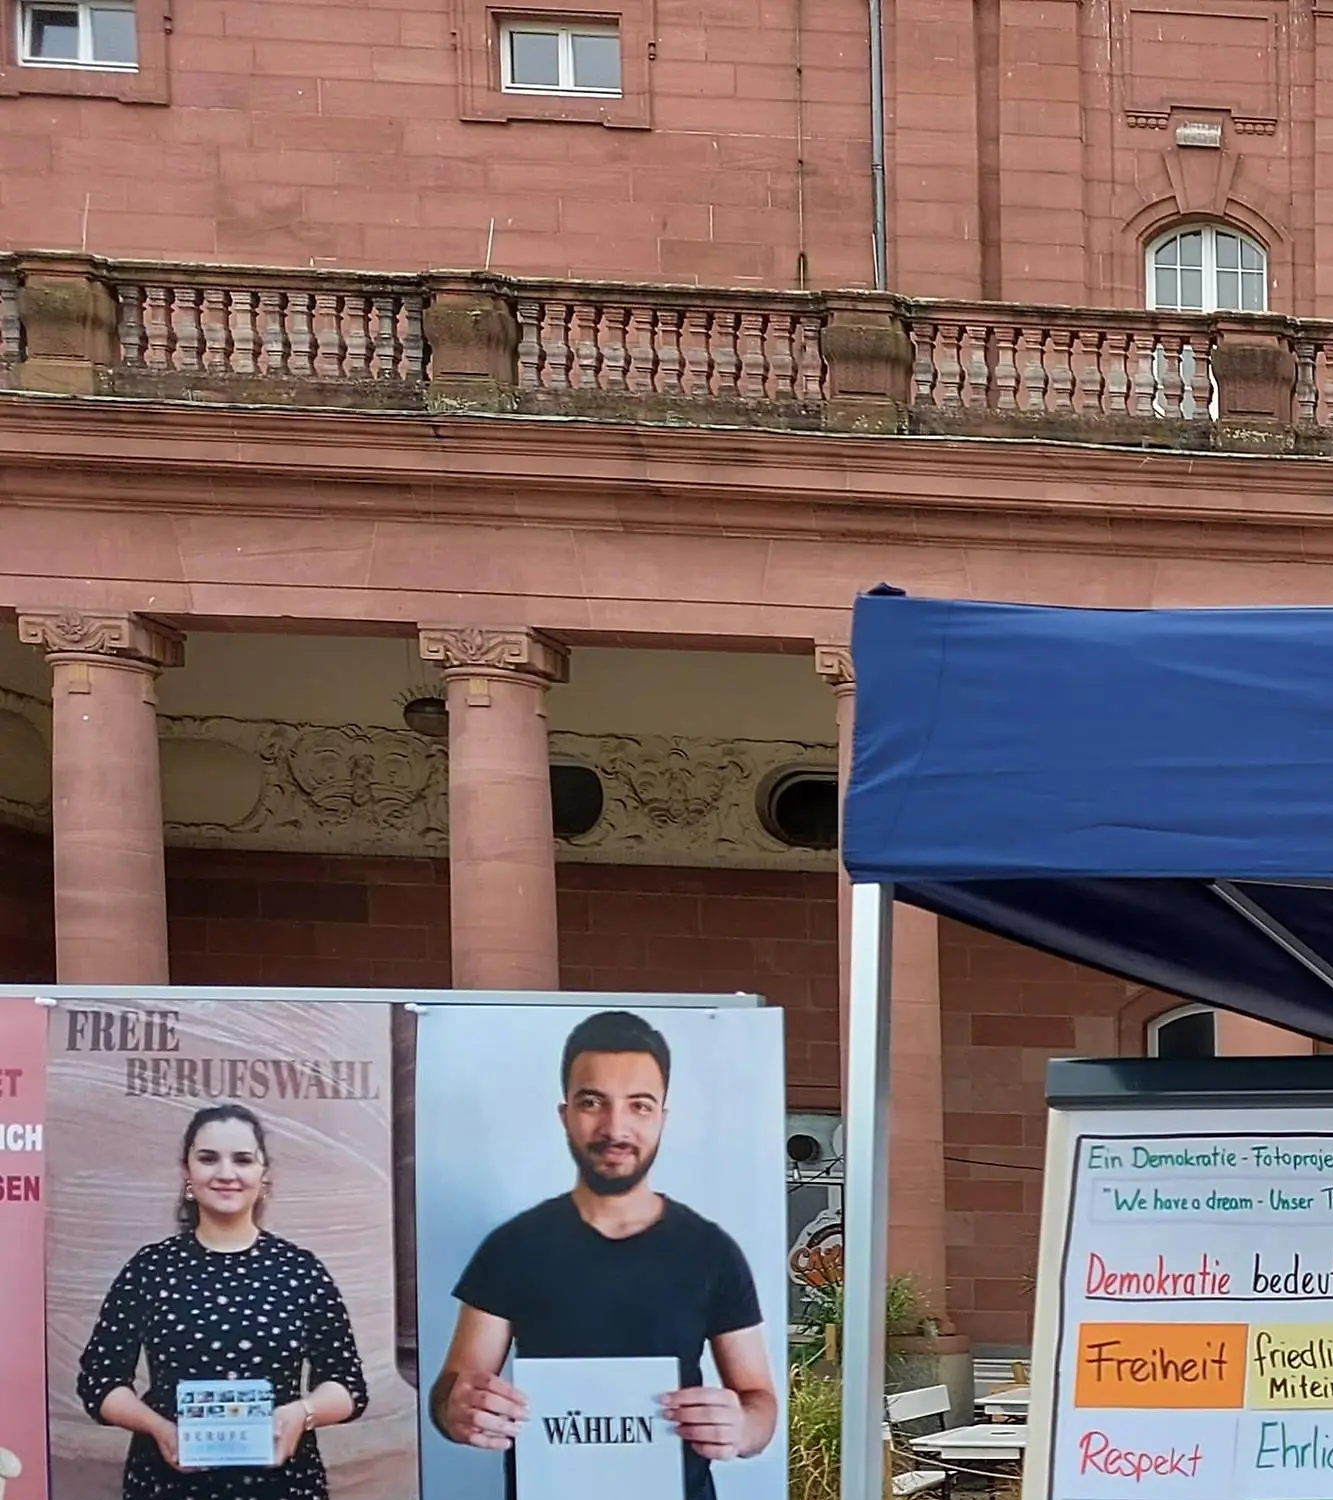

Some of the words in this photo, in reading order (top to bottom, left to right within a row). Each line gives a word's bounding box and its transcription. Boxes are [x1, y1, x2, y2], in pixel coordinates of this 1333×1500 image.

[66, 1010, 180, 1052] FREIE
[125, 1058, 381, 1101] BERUFSWAHL
[1088, 1144, 1122, 1169] Ein
[1132, 1146, 1236, 1168] Demokratie
[1154, 1189, 1188, 1210] have
[1206, 1190, 1252, 1210] dream
[1270, 1189, 1314, 1210] Unser
[1085, 1254, 1230, 1295] Demokratie
[1086, 1341, 1228, 1382] Freiheit
[543, 1410, 653, 1445] WÄHLEN
[1080, 1432, 1202, 1482] Respekt
